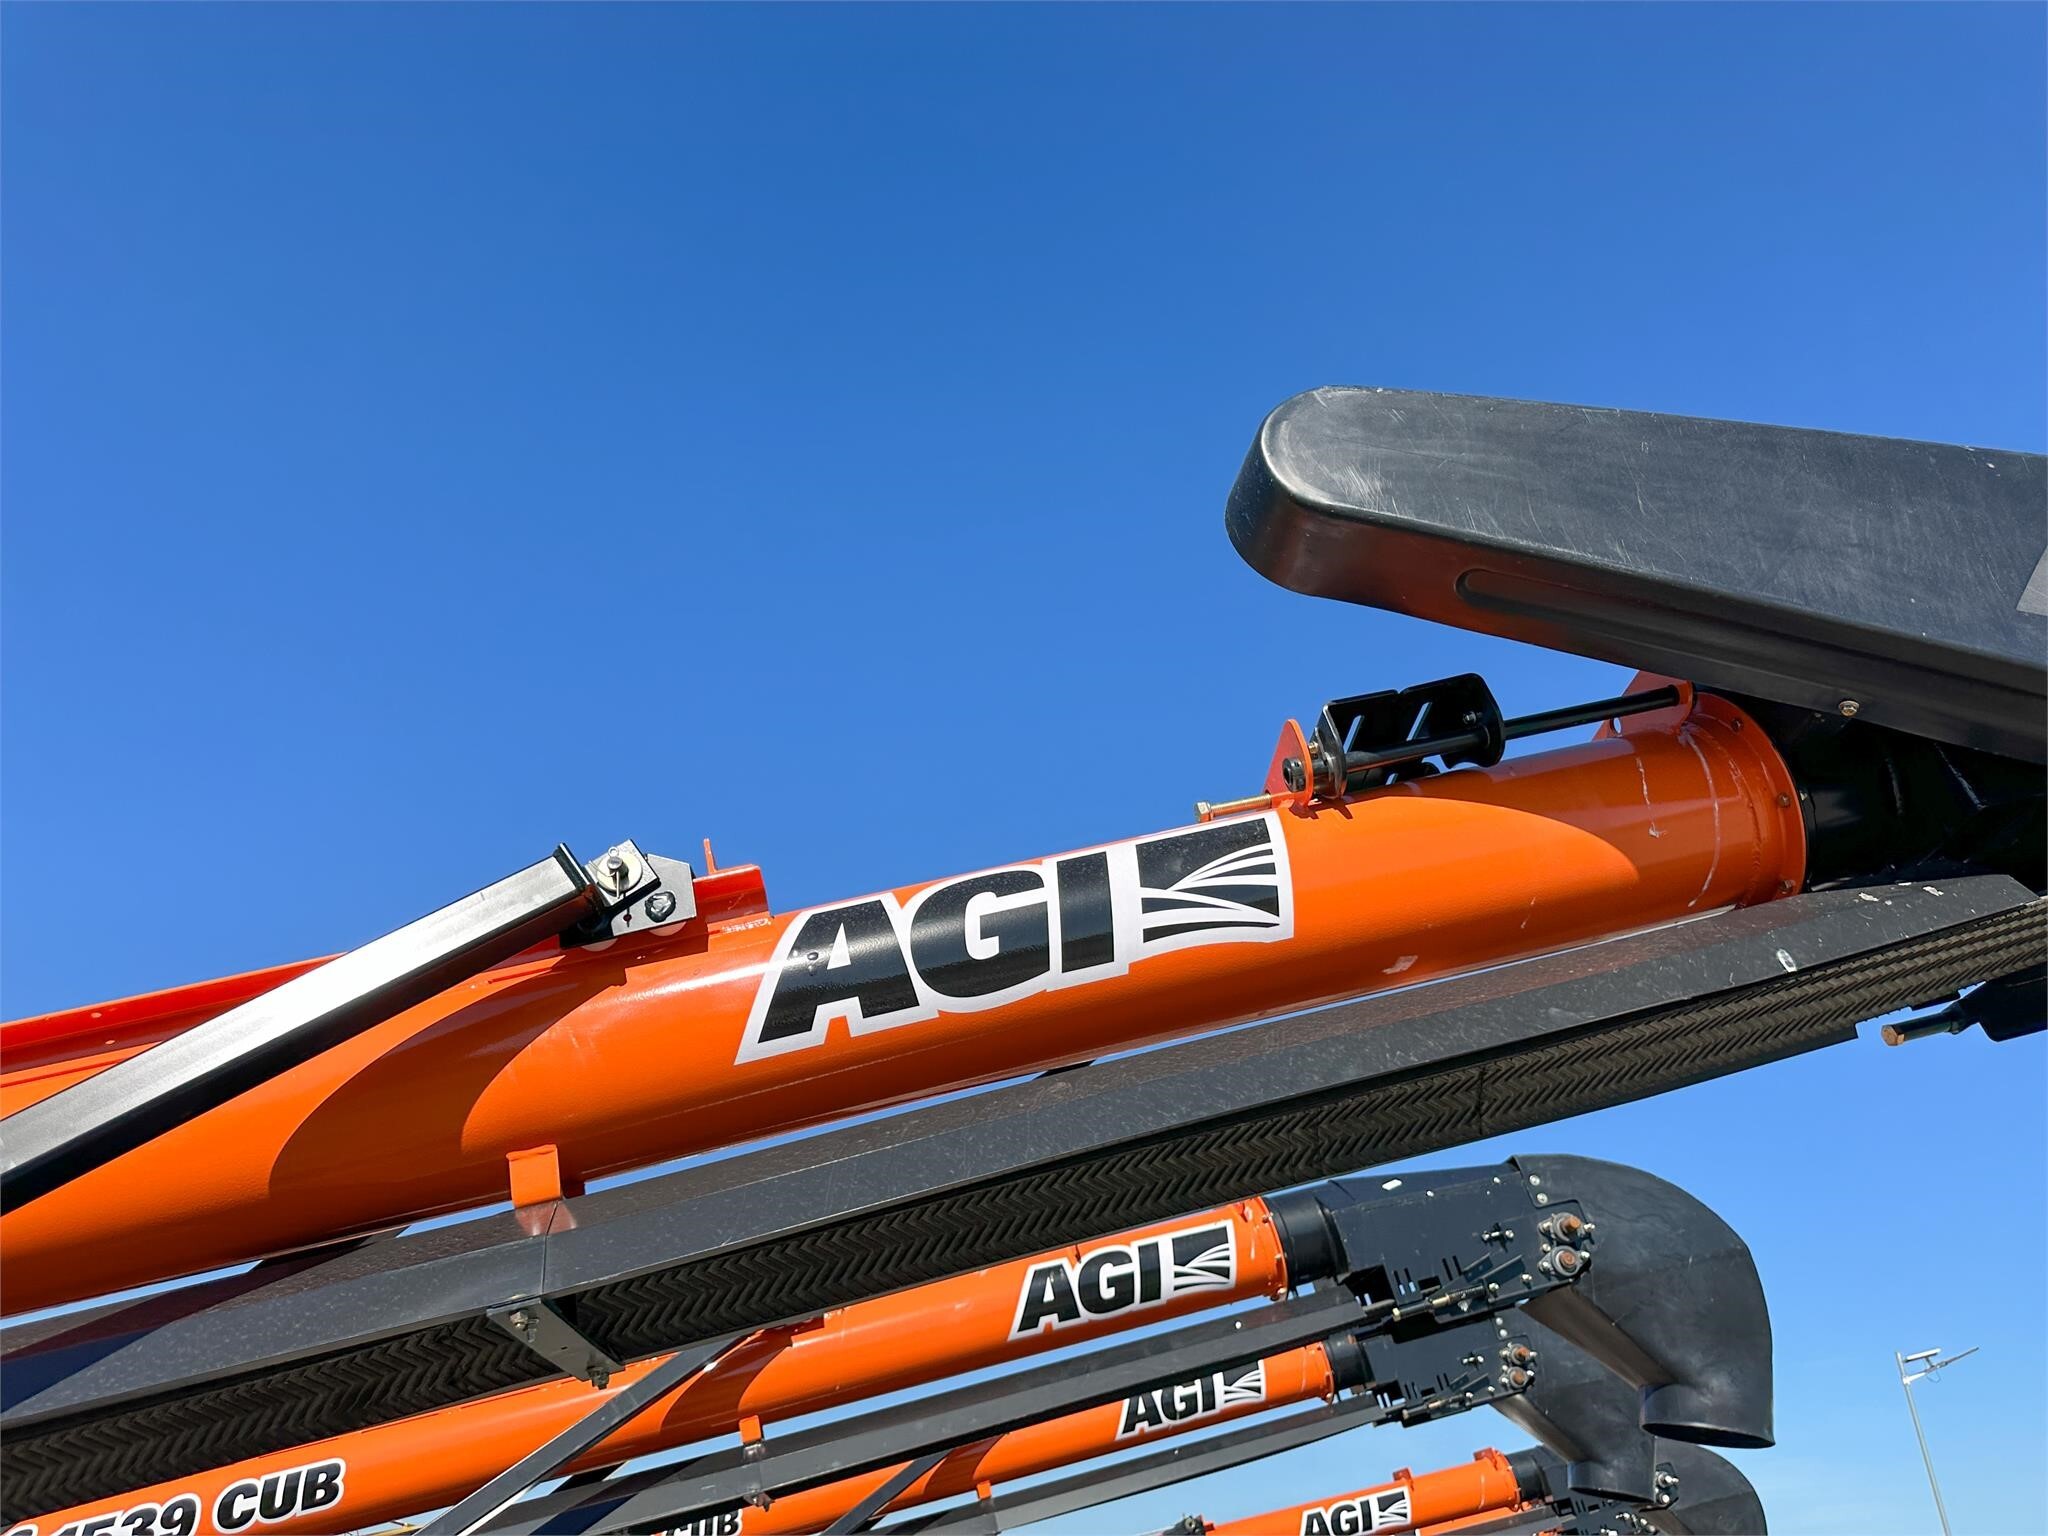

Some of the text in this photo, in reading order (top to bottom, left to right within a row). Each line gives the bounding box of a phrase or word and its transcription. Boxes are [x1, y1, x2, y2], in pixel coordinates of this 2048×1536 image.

[758, 851, 1115, 1043] AGI
[1017, 1241, 1161, 1332] AGI
[1122, 1375, 1216, 1434] AGI
[57, 1462, 342, 1536] 39 CUB
[1305, 1499, 1372, 1536] AGI
